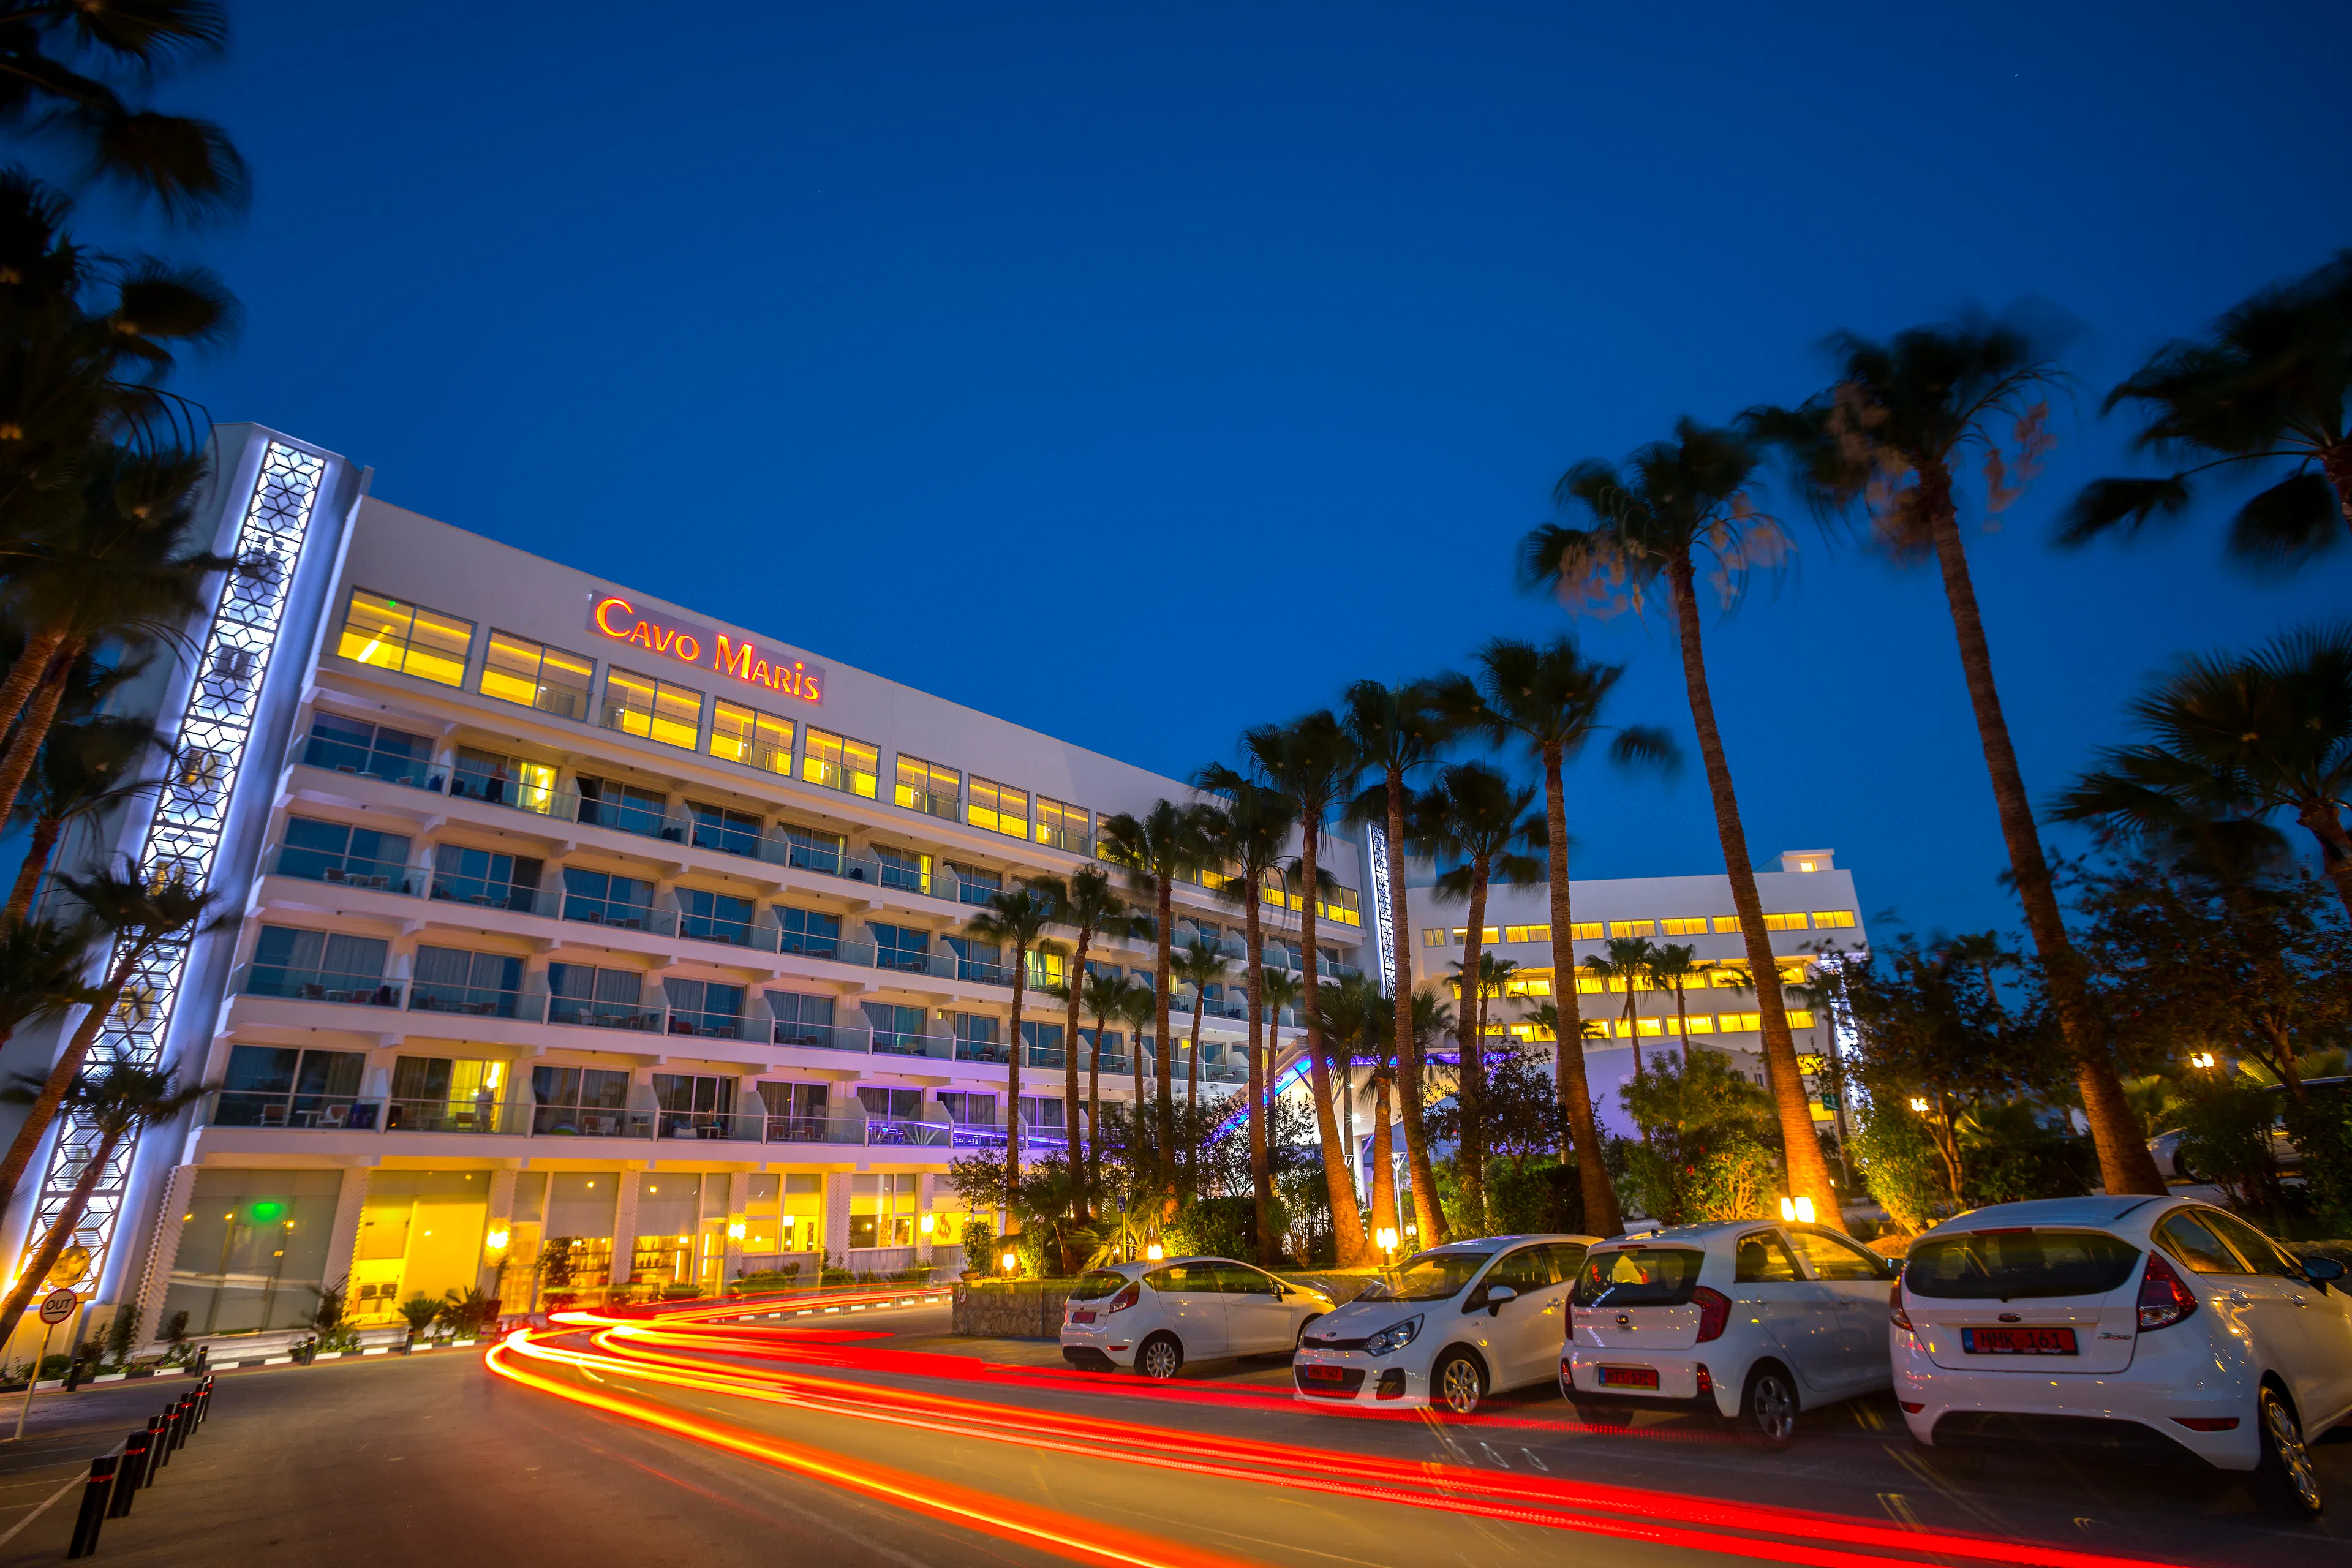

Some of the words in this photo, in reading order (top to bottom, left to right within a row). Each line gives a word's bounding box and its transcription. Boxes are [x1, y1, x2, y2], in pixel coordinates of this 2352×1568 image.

[45, 1298, 72, 1310] OUT
[1980, 1331, 2016, 1348] MMK
[2026, 1331, 2063, 1348] 161
